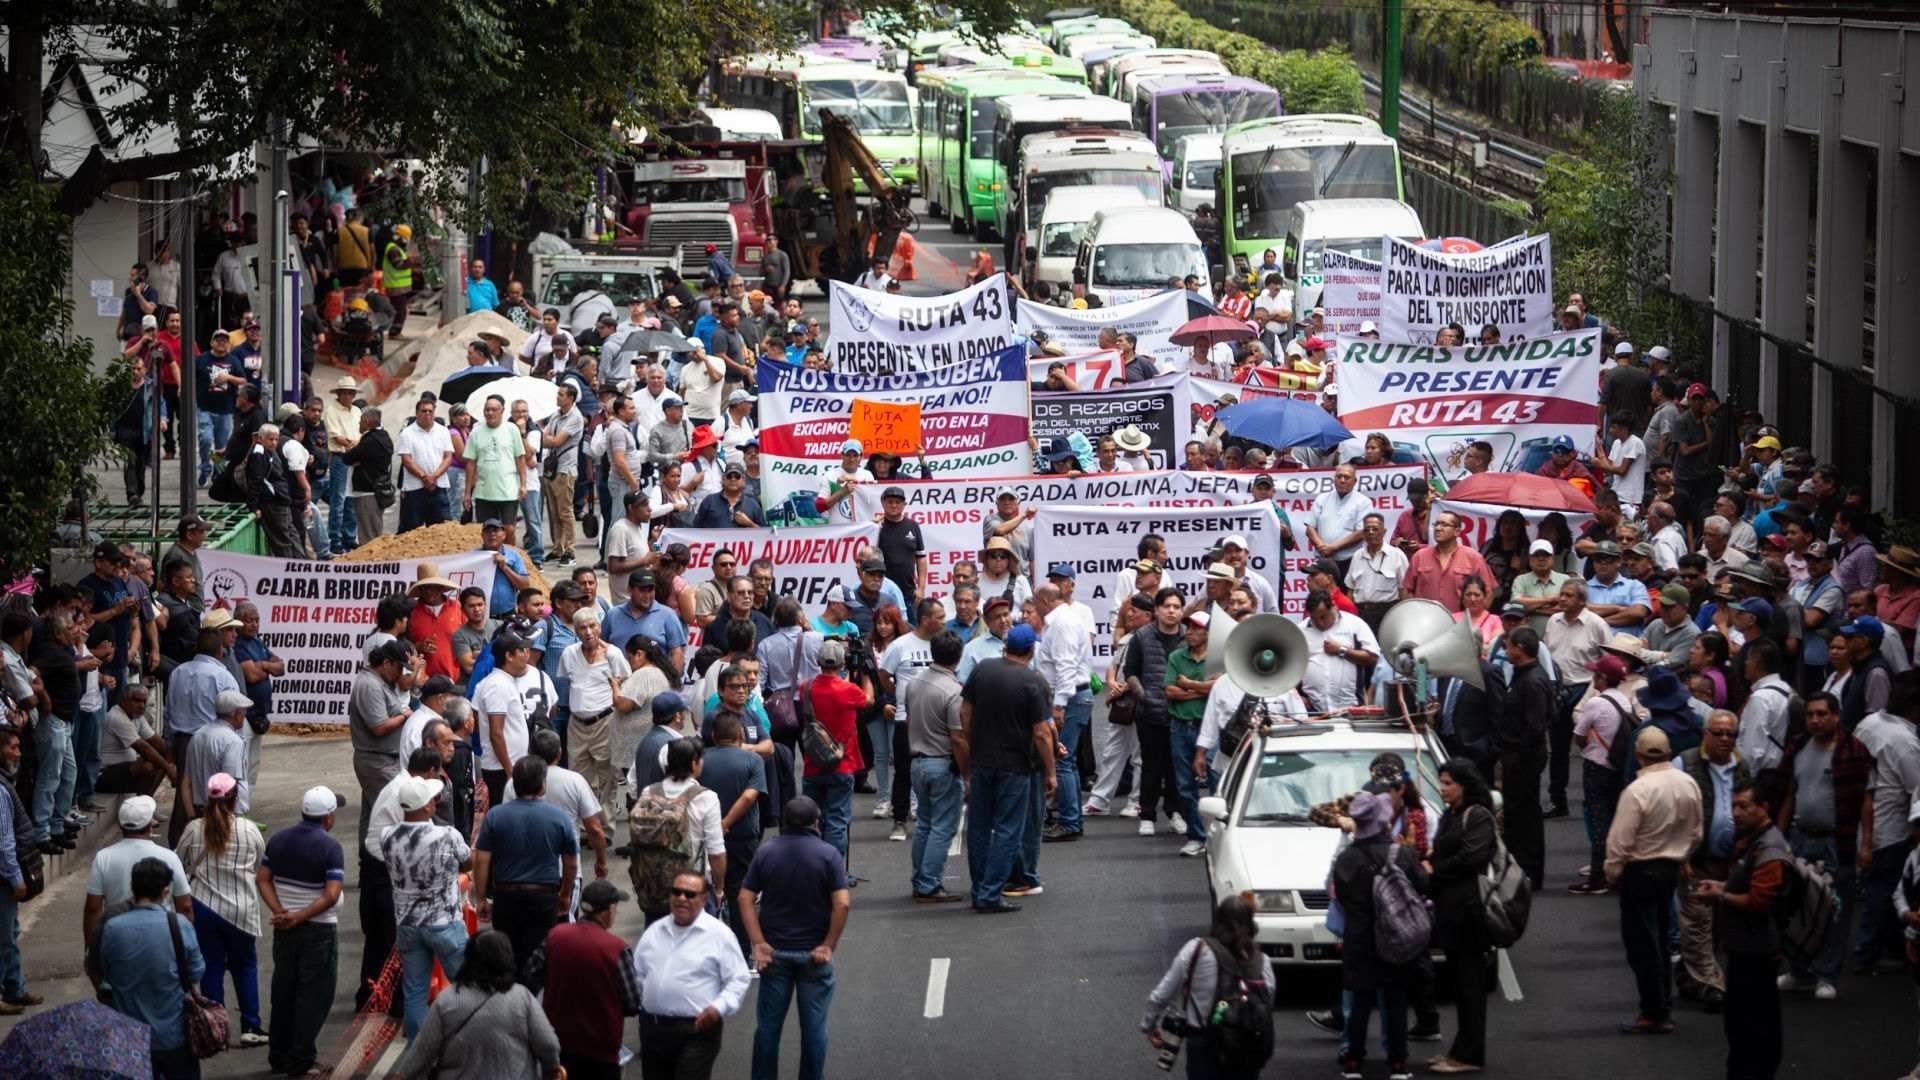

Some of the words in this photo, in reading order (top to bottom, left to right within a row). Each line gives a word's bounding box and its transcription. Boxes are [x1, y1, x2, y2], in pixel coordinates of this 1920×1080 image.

[1324, 253, 1347, 269] CLARA
[1390, 242, 1417, 268] POR
[1420, 252, 1448, 273] UNA
[1452, 254, 1500, 273] TARIFA
[1501, 242, 1544, 270] JUSTA
[1387, 269, 1425, 295] PARA
[1425, 273, 1441, 297] LA
[1445, 269, 1546, 298] DIGNIFICACION
[898, 301, 967, 332] RUTA
[973, 288, 1003, 321] 43
[1333, 307, 1356, 317] SERVICIO
[1356, 307, 1380, 317] PUBLICOS
[1407, 299, 1433, 324] DEL
[1436, 299, 1527, 326] TRANSPORTE
[837, 341, 917, 373] PRESENTE
[917, 344, 928, 371] Y
[931, 343, 951, 369] EN
[1343, 341, 1452, 364] RUTAS
[1463, 335, 1597, 362] UNIDAS
[833, 373, 918, 392] COSTOS
[1378, 366, 1562, 393] PRESENTE
[789, 396, 844, 414] PERO
[949, 385, 993, 406] NO!!
[1034, 404, 1063, 417] DE
[1069, 398, 1165, 416] REZAGOS
[863, 405, 903, 422] RUTA
[949, 416, 969, 429] EN
[970, 414, 989, 428] LA
[1050, 418, 1071, 427] DEL
[1074, 414, 1143, 426] TRANSPORTE
[1388, 400, 1483, 427] RUTA
[1491, 401, 1545, 424] 43
[872, 423, 894, 436] 73
[1094, 424, 1109, 433] DE
[863, 439, 910, 450] APOYA
[925, 436, 935, 449] Y
[935, 431, 986, 449] DIGNA!
[771, 461, 818, 476] PARA
[964, 483, 1078, 504] BRGADA
[1085, 477, 1177, 500] MOLINA,
[1185, 476, 1245, 494] JEFA
[1285, 473, 1406, 494] GOBRNO
[1052, 521, 1110, 537] RUTA
[1116, 520, 1141, 535] 47
[1149, 515, 1263, 534] PRESENTE
[760, 535, 870, 565] AUMENTO
[284, 562, 312, 573] JEFA
[314, 563, 332, 573] DE
[334, 562, 401, 575] GOBIERNO
[255, 577, 321, 600] CLARA
[1092, 585, 1107, 599] A
[271, 605, 309, 624] RUTA
[311, 606, 321, 623] 4
[309, 632, 353, 650] DIGNO,
[287, 659, 353, 675] GOBIERNO
[271, 679, 352, 695] HOMOLOGAR
[277, 699, 326, 714] ESTADO
[328, 700, 345, 715] DE
